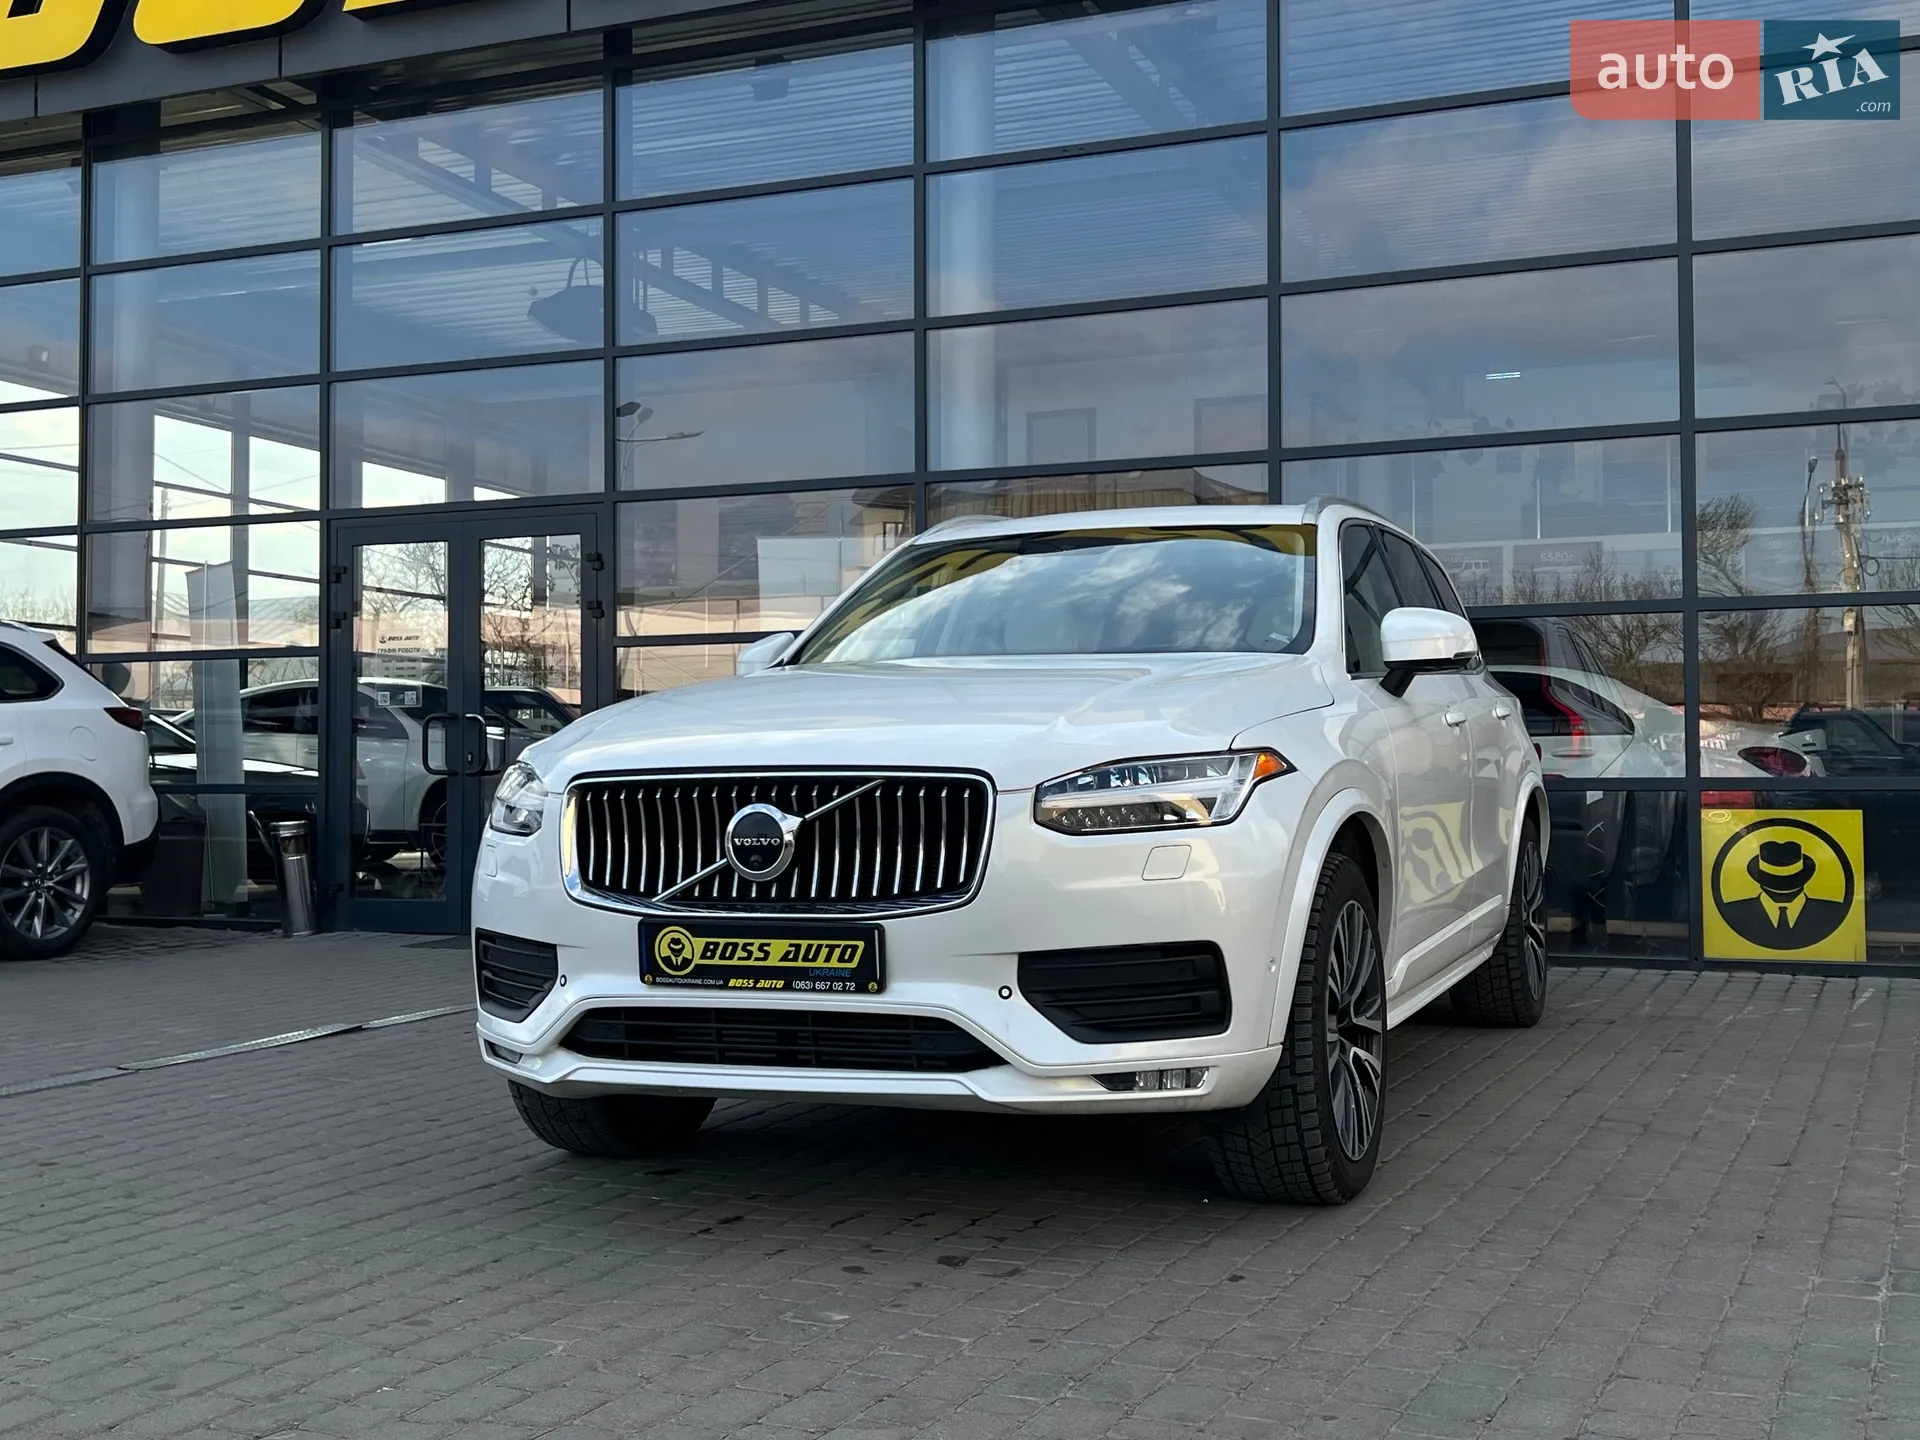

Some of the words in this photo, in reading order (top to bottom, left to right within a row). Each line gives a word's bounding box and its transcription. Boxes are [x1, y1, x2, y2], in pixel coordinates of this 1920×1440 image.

[733, 838, 781, 846] VOLVO
[699, 941, 772, 962] BOSS
[778, 942, 860, 964] AUTO
[808, 968, 852, 978] UKRAINE
[728, 979, 755, 988] BOSS
[756, 979, 785, 989] AUTO
[792, 980, 814, 990] (063)
[815, 981, 830, 990] 667
[832, 982, 843, 991] 02
[845, 982, 856, 991] 72
